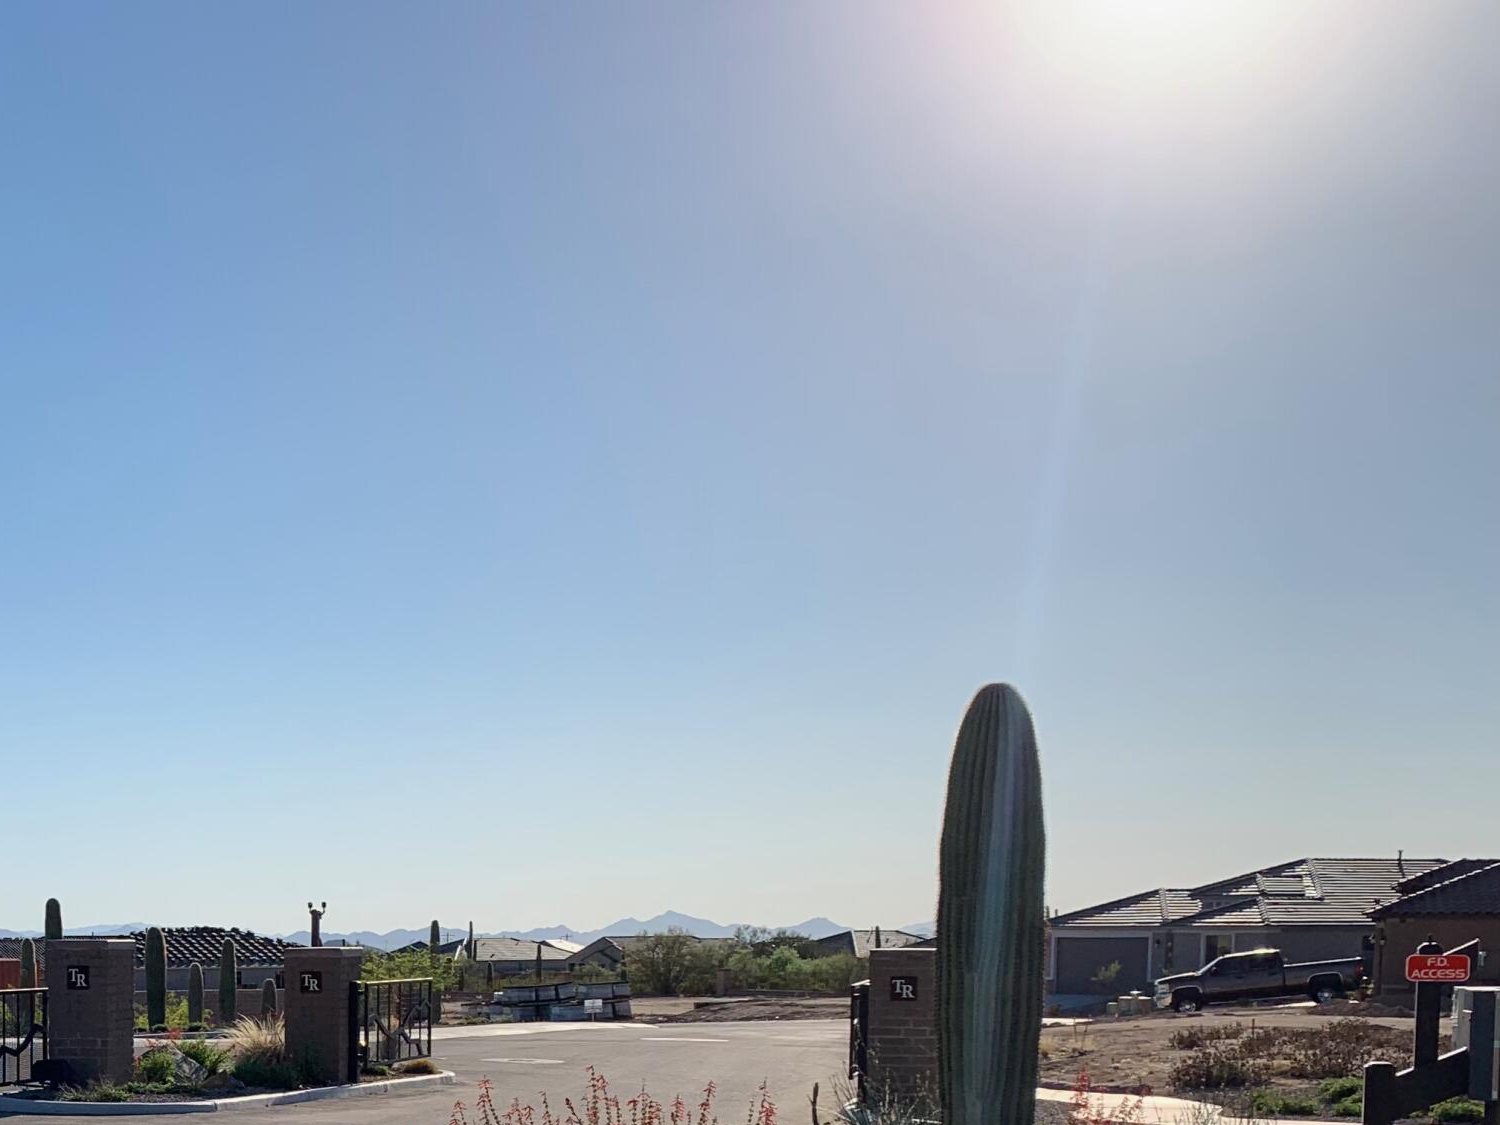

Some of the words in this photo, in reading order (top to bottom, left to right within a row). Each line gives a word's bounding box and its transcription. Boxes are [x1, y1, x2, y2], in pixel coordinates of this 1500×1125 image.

[68, 968, 87, 987] TR
[301, 974, 320, 991] TR
[1411, 969, 1466, 978] ACCESS
[891, 979, 916, 998] TR
